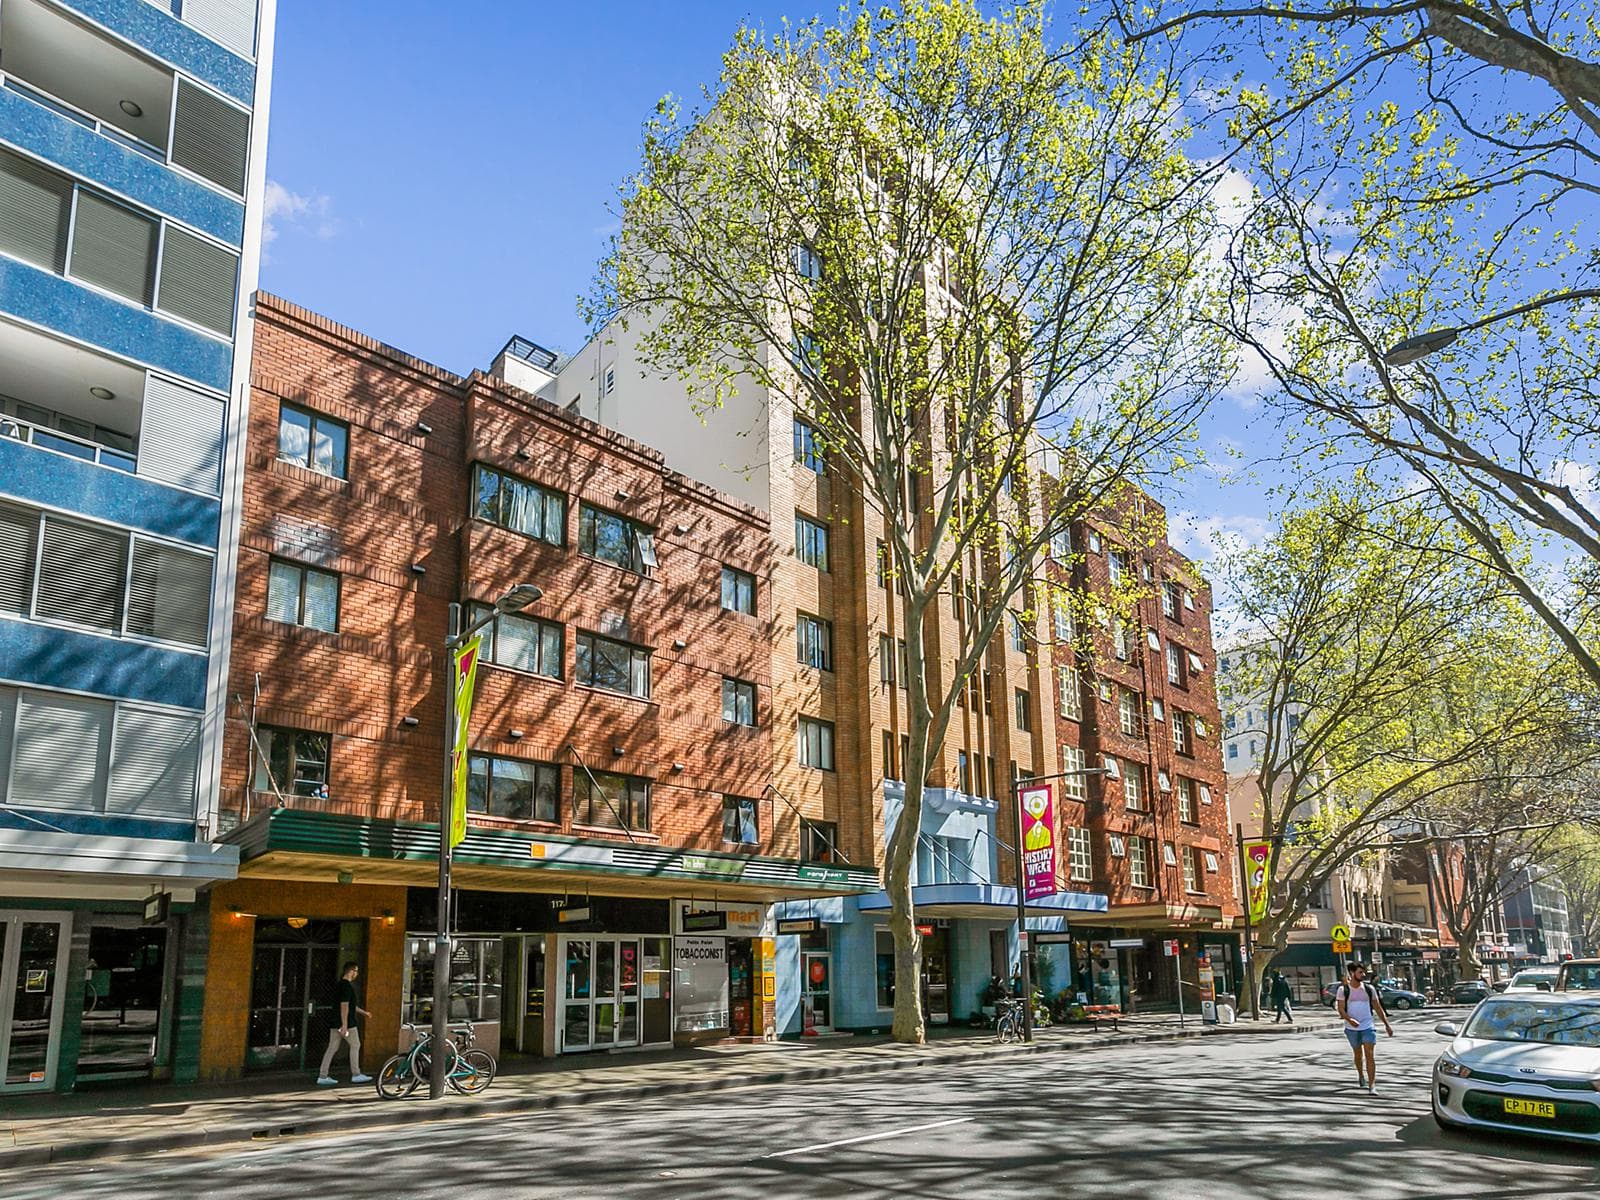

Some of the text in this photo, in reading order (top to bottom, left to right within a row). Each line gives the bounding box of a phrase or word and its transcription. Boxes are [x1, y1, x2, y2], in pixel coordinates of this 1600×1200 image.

[675, 947, 724, 960] TOBACCONIST
[1506, 1100, 1553, 1114] CP 17 RE
